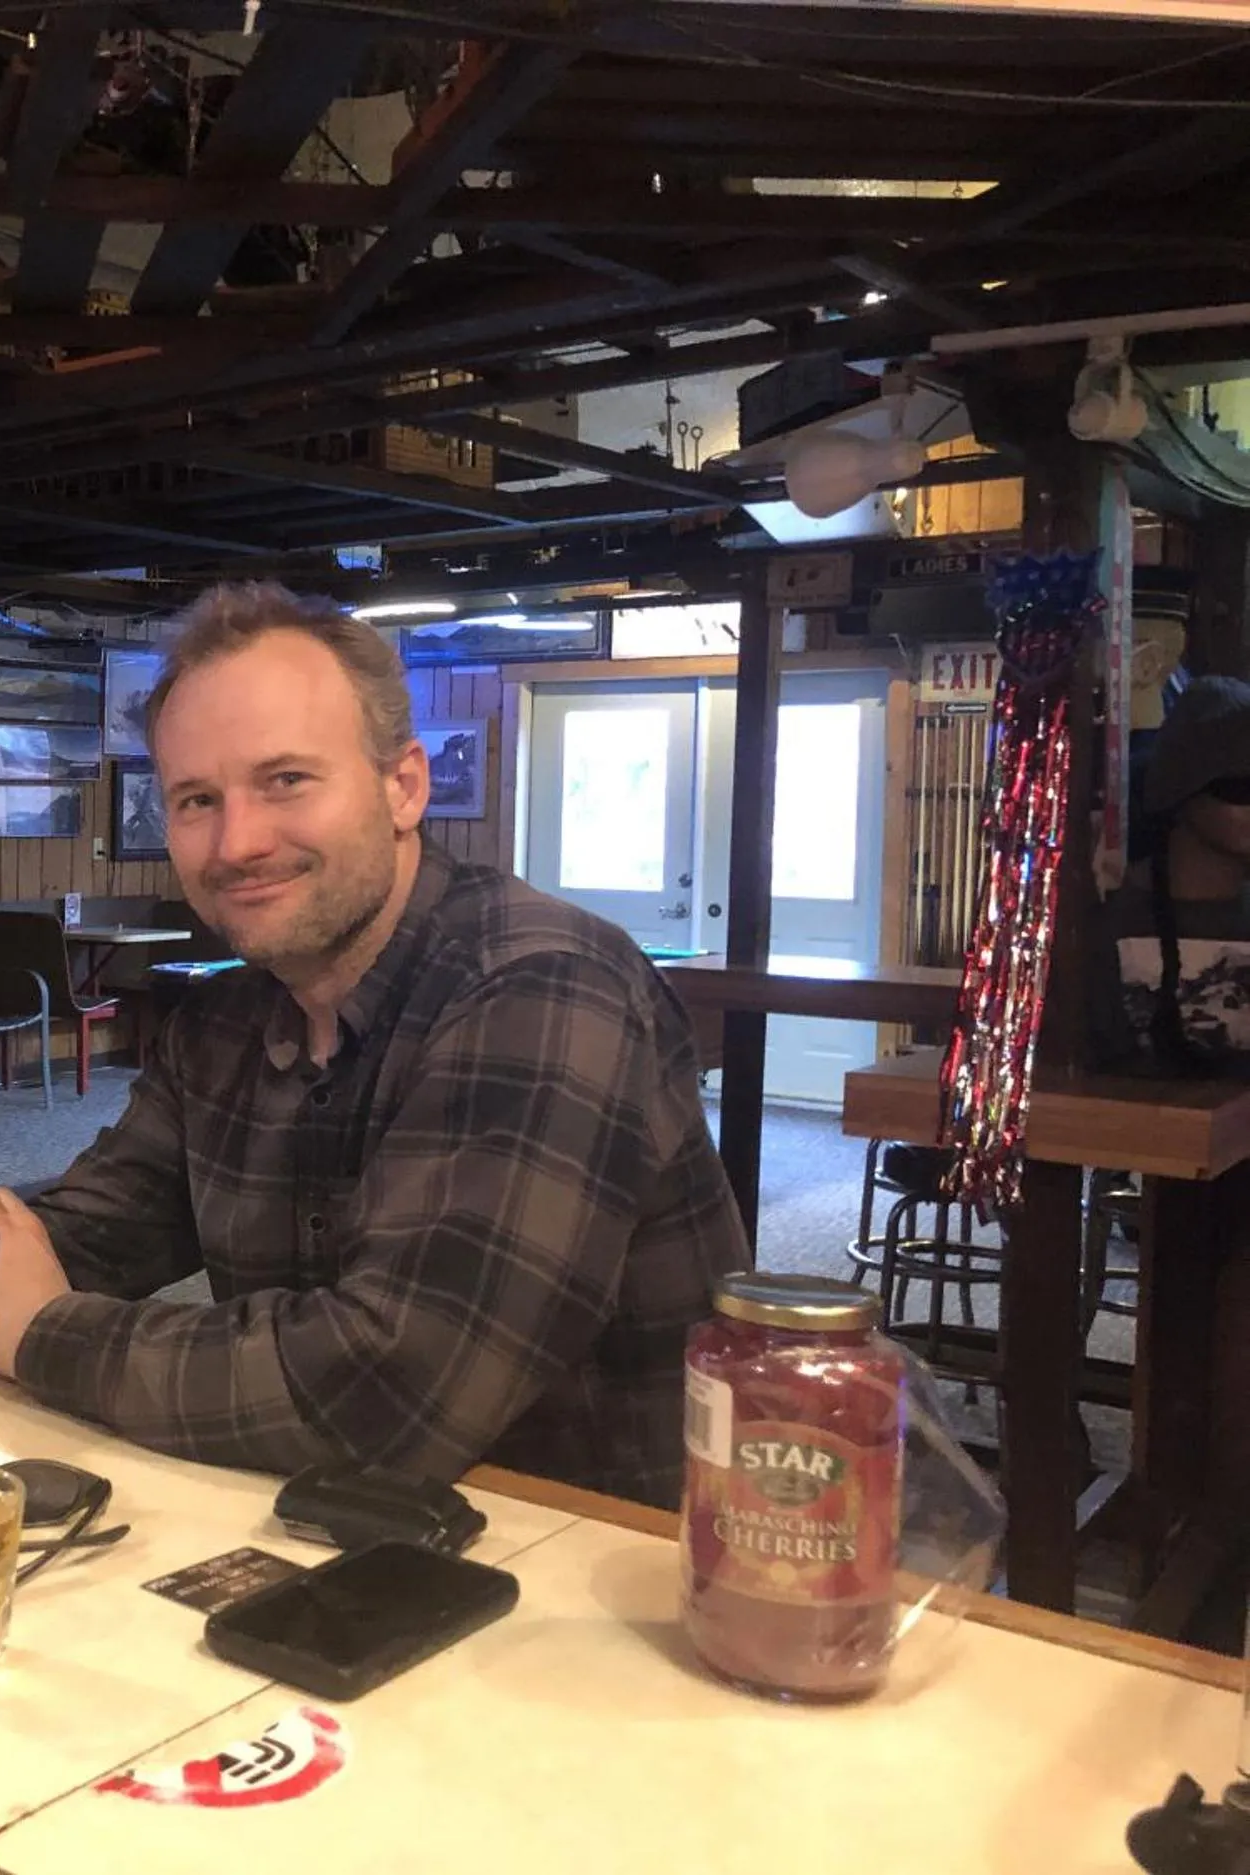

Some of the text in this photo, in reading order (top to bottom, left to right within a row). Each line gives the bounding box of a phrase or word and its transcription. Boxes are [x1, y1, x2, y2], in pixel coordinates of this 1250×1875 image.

[933, 654, 997, 690] EXIT
[739, 1442, 833, 1481] STAR
[714, 1520, 857, 1561] CHERRIES
